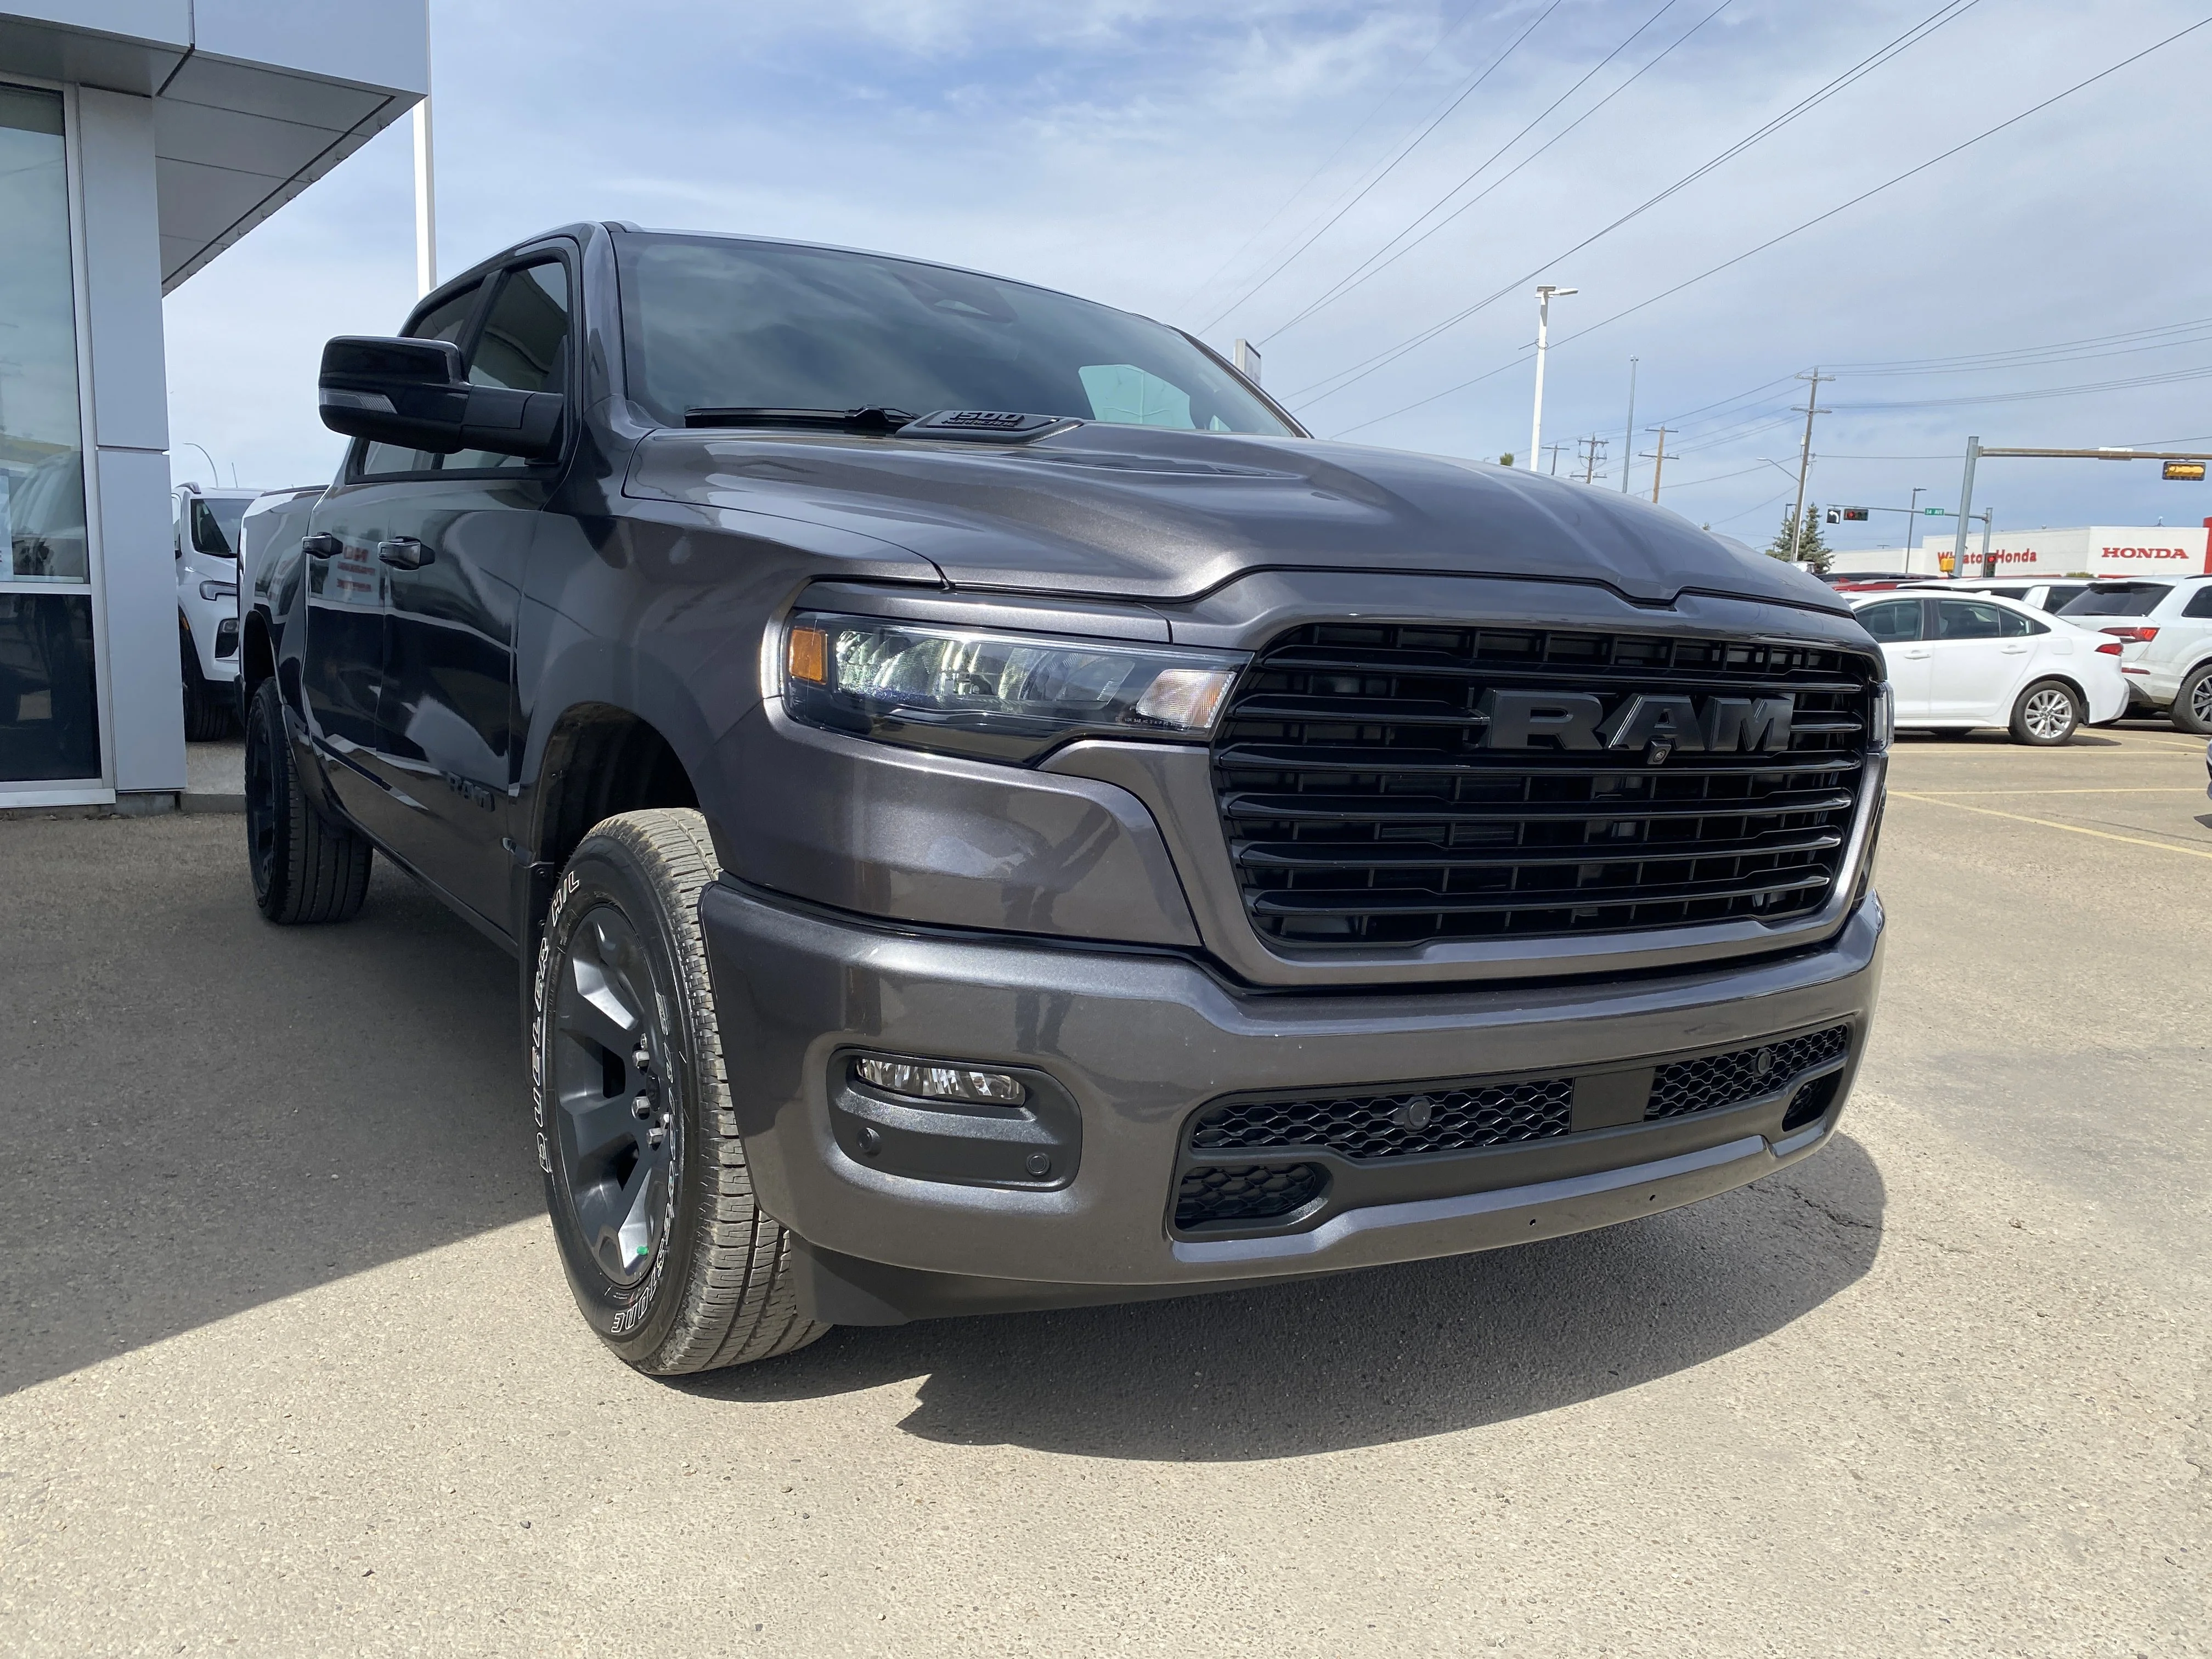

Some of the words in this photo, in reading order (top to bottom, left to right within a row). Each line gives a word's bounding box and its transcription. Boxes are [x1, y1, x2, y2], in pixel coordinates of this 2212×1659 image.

[949, 411, 1025, 423] 1500
[1996, 549, 2036, 563] Honda
[2102, 548, 2189, 559] HONDA
[1477, 688, 1796, 752] RAM
[447, 771, 495, 812] RAM
[532, 936, 549, 1173] DUELER
[611, 991, 676, 1333] BRIDGESTONE
